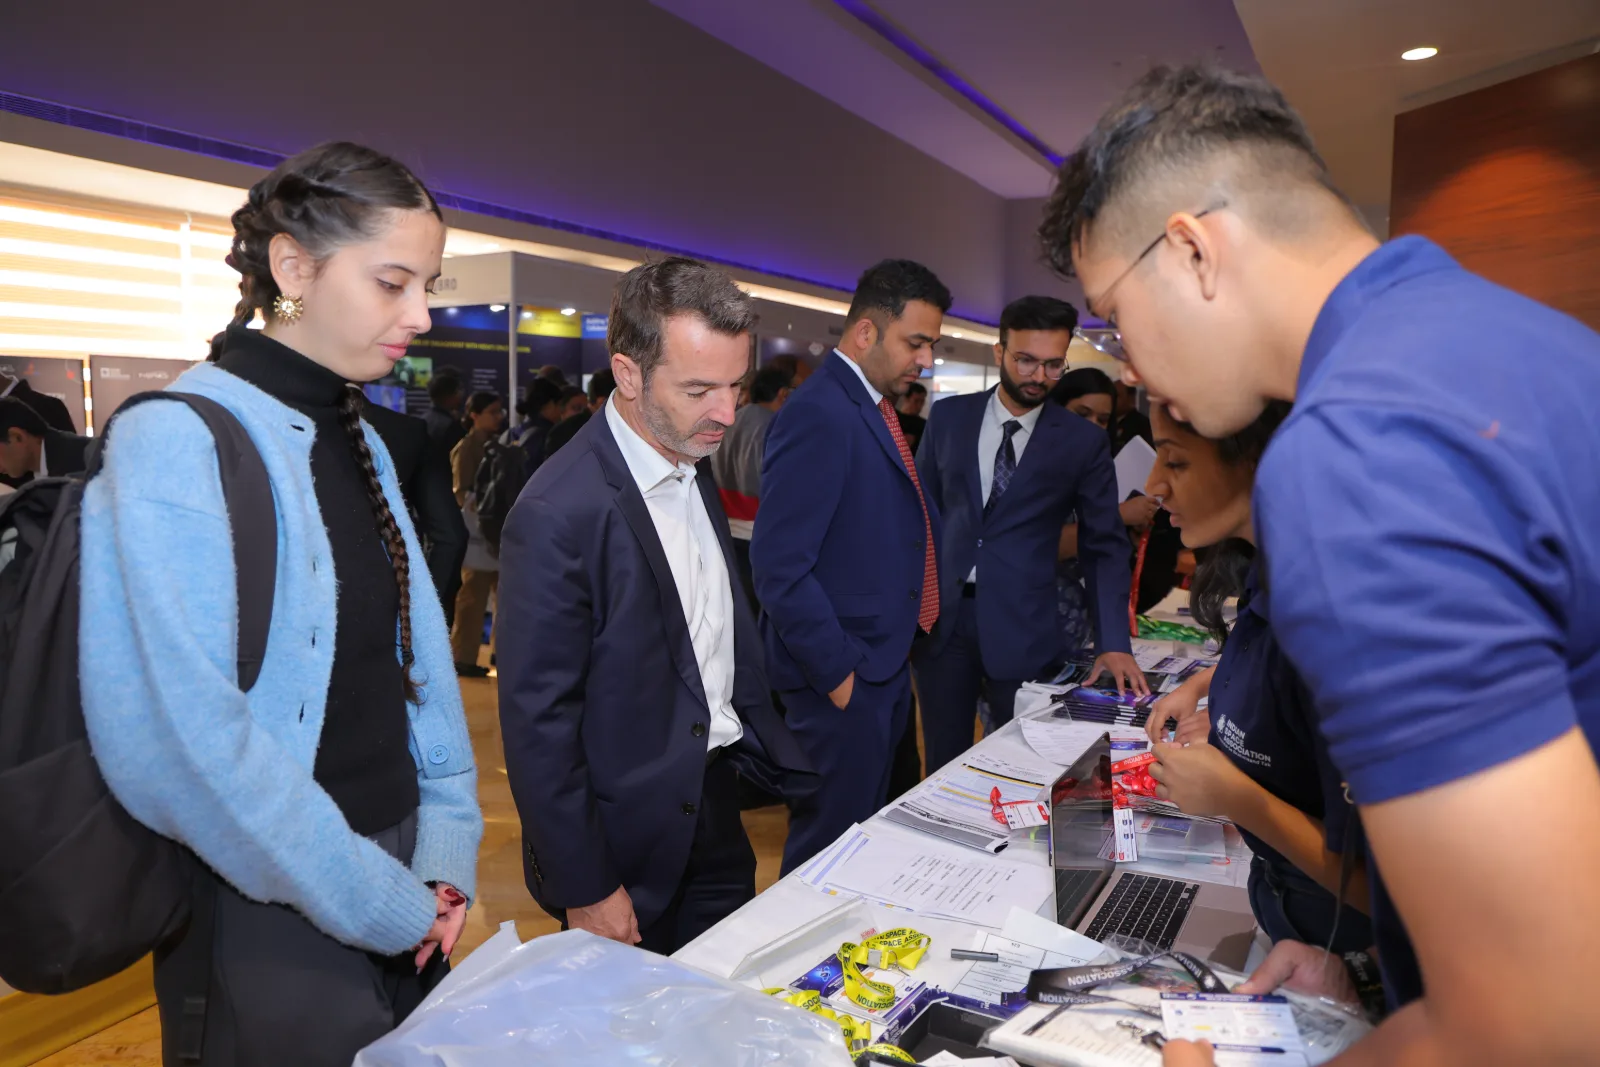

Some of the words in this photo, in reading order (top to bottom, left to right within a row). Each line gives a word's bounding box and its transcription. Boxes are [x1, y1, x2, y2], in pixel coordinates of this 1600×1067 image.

[1224, 727, 1245, 748] SPACE
[1226, 719, 1246, 740] INDIAN
[1223, 735, 1271, 762] ASSOCIATION
[1123, 755, 1143, 765] INDIAN
[880, 938, 903, 947] SPACE
[885, 929, 907, 940] SPACE
[1067, 966, 1134, 987] ASSOCIATION
